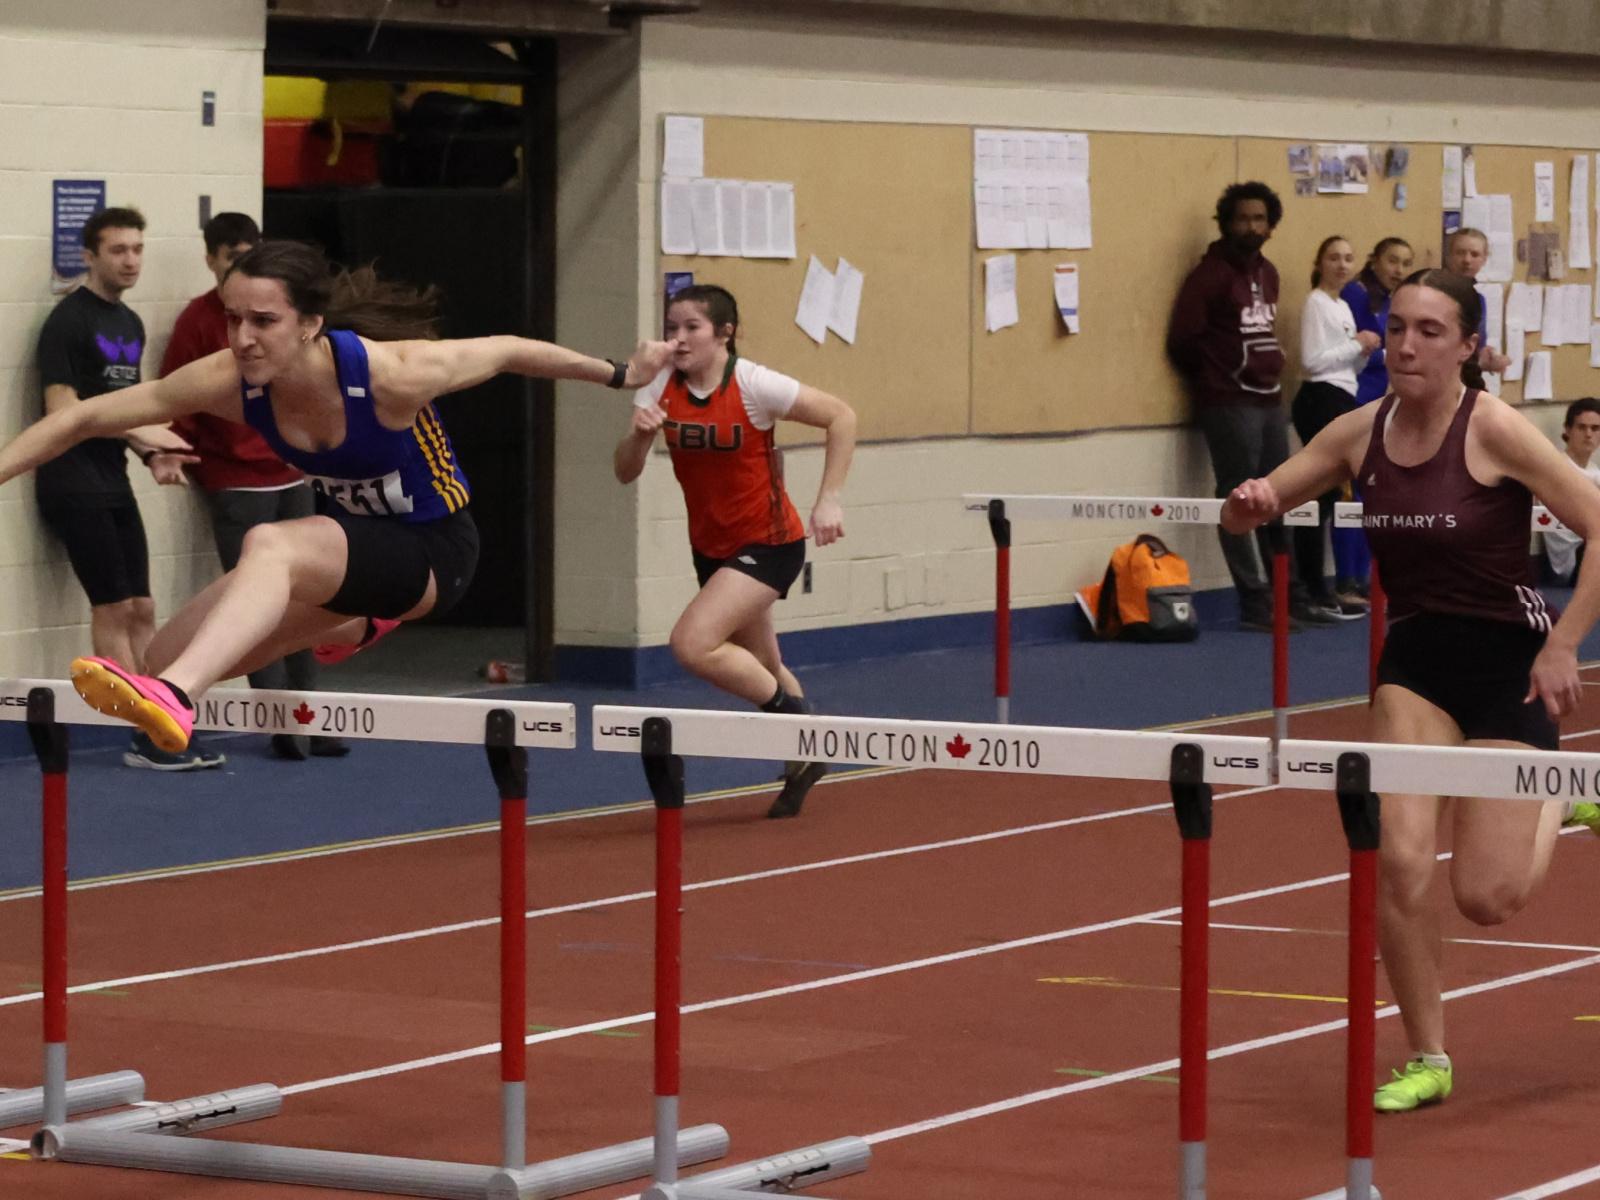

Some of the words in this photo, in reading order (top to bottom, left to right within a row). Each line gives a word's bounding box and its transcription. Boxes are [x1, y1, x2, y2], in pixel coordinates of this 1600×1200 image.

[1071, 503, 1147, 519] MONCTON
[1168, 505, 1200, 520] 2010
[1364, 515, 1389, 528] AINT
[192, 701, 286, 728] ONCTON
[321, 705, 375, 733] 2010
[523, 721, 562, 732] UCS
[600, 726, 640, 737] UCS
[798, 729, 937, 763] MONCTON
[978, 738, 1040, 768] 2010
[1213, 757, 1259, 768] UCS
[1287, 762, 1334, 773] UCS
